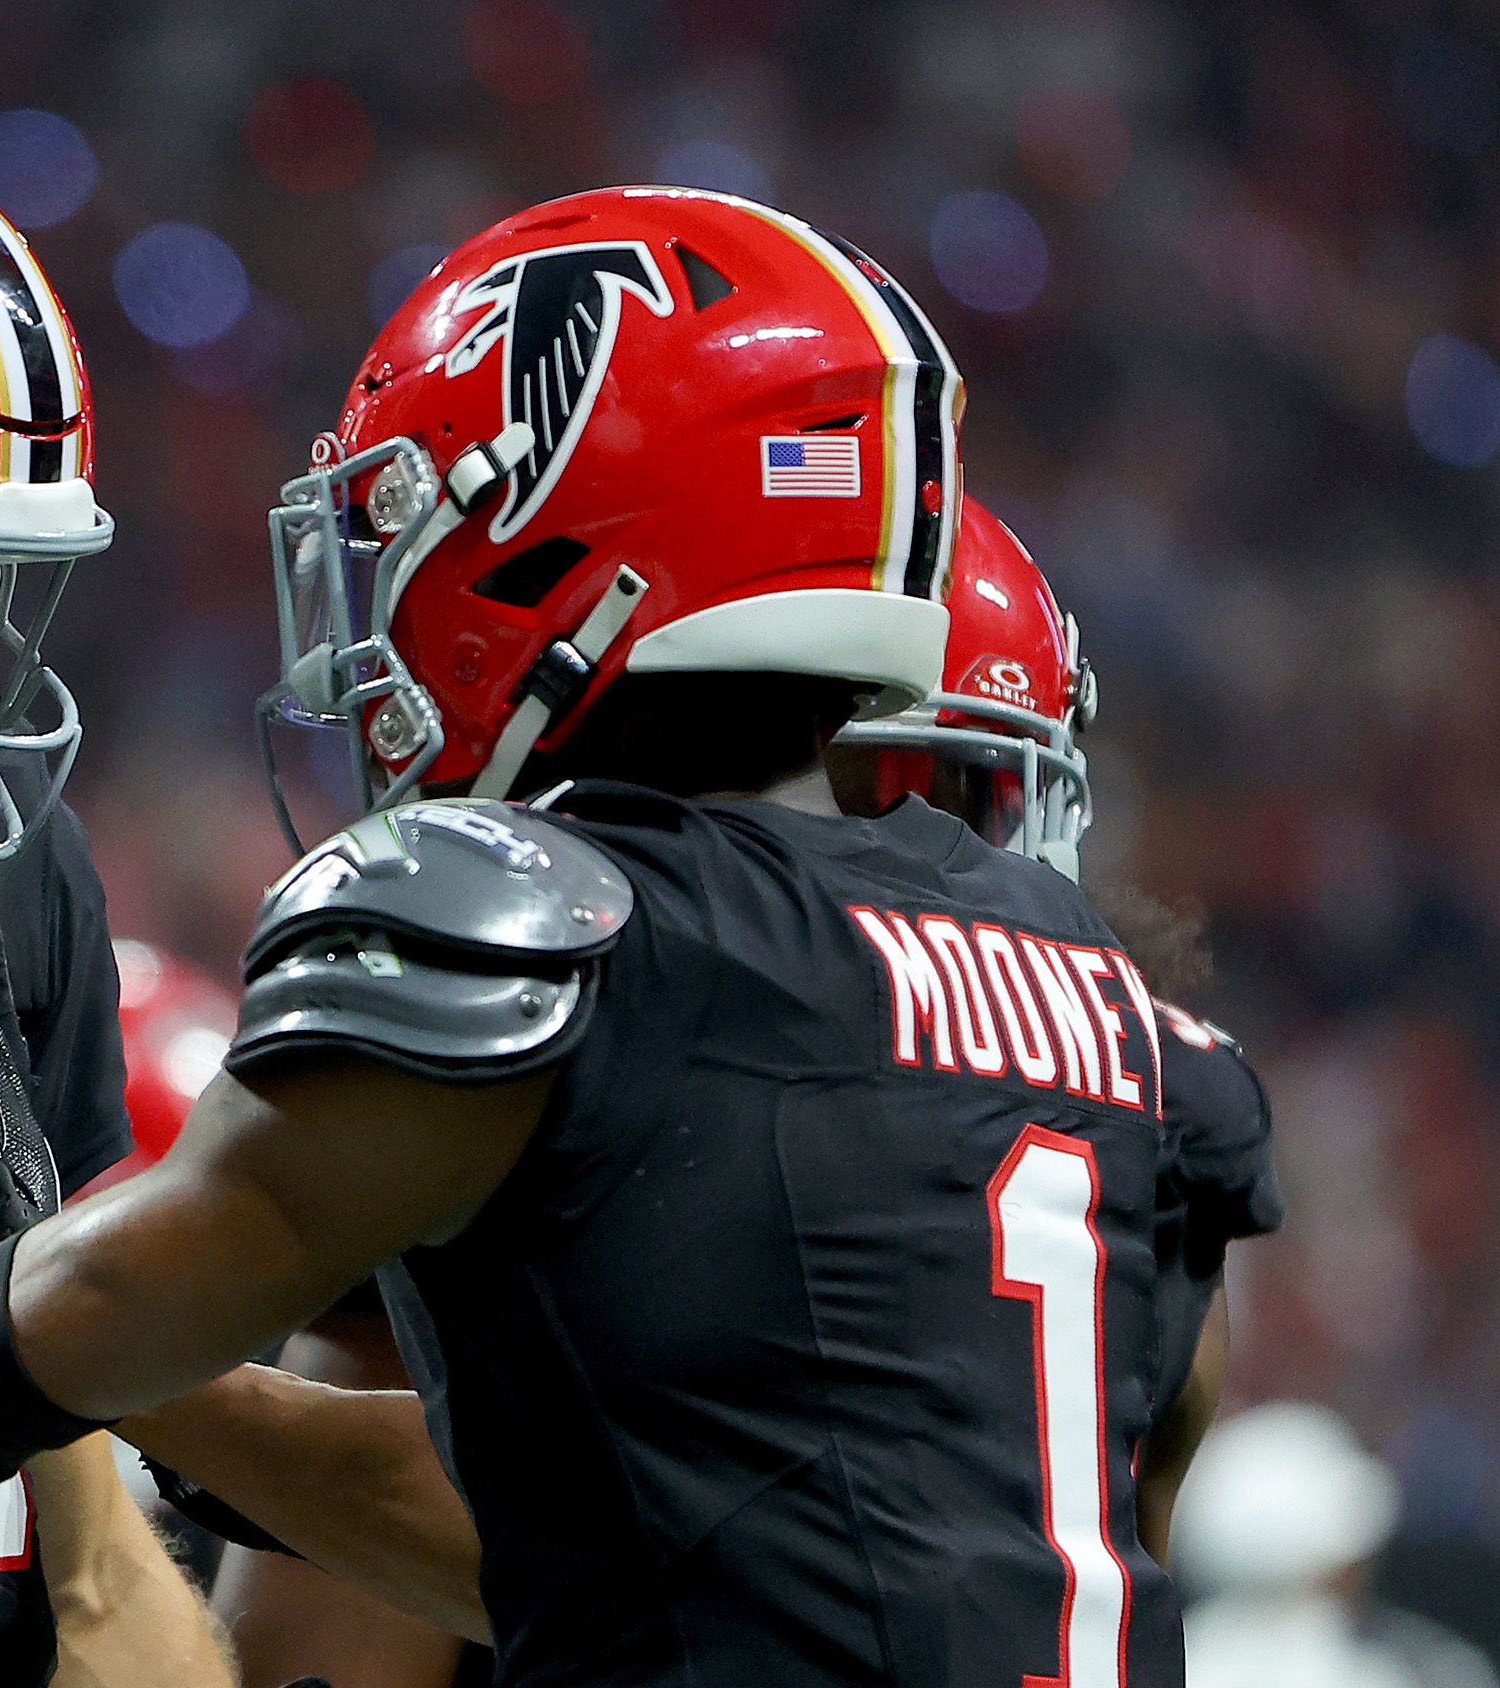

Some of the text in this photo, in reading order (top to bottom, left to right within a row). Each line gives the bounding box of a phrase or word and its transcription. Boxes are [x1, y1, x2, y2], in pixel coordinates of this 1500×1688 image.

[979, 680, 1038, 711] OAKLEY
[849, 905, 1164, 1121] MOONEY
[986, 1123, 1132, 1688] 1
